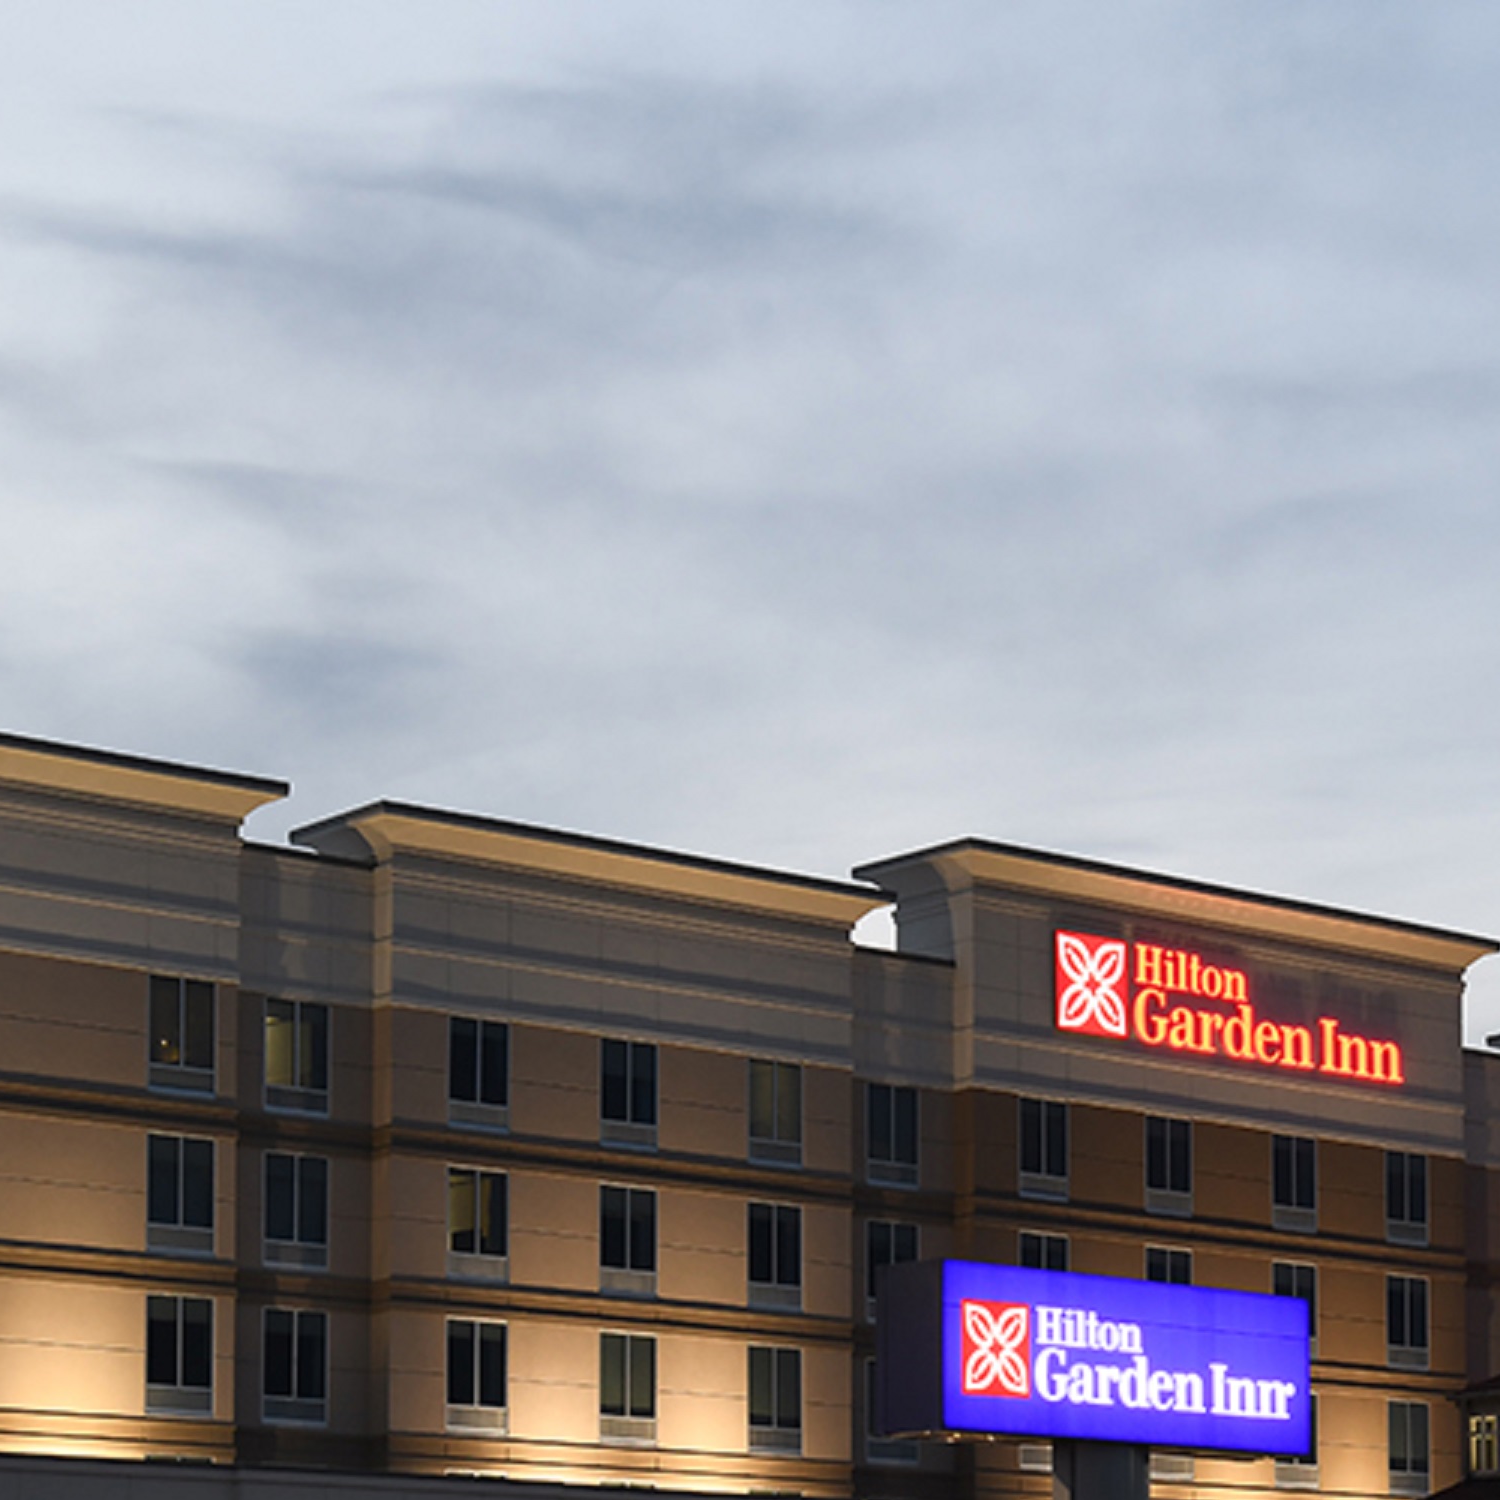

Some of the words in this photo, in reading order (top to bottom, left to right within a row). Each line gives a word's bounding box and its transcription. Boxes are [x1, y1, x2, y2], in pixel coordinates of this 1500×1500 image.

[1133, 943, 1249, 1001] Hilton
[1133, 987, 1315, 1070] Garden
[1318, 1017, 1404, 1084] Inn
[1035, 1305, 1142, 1354] Hilton
[1034, 1347, 1206, 1414] Garden
[1208, 1362, 1295, 1419] Inn
